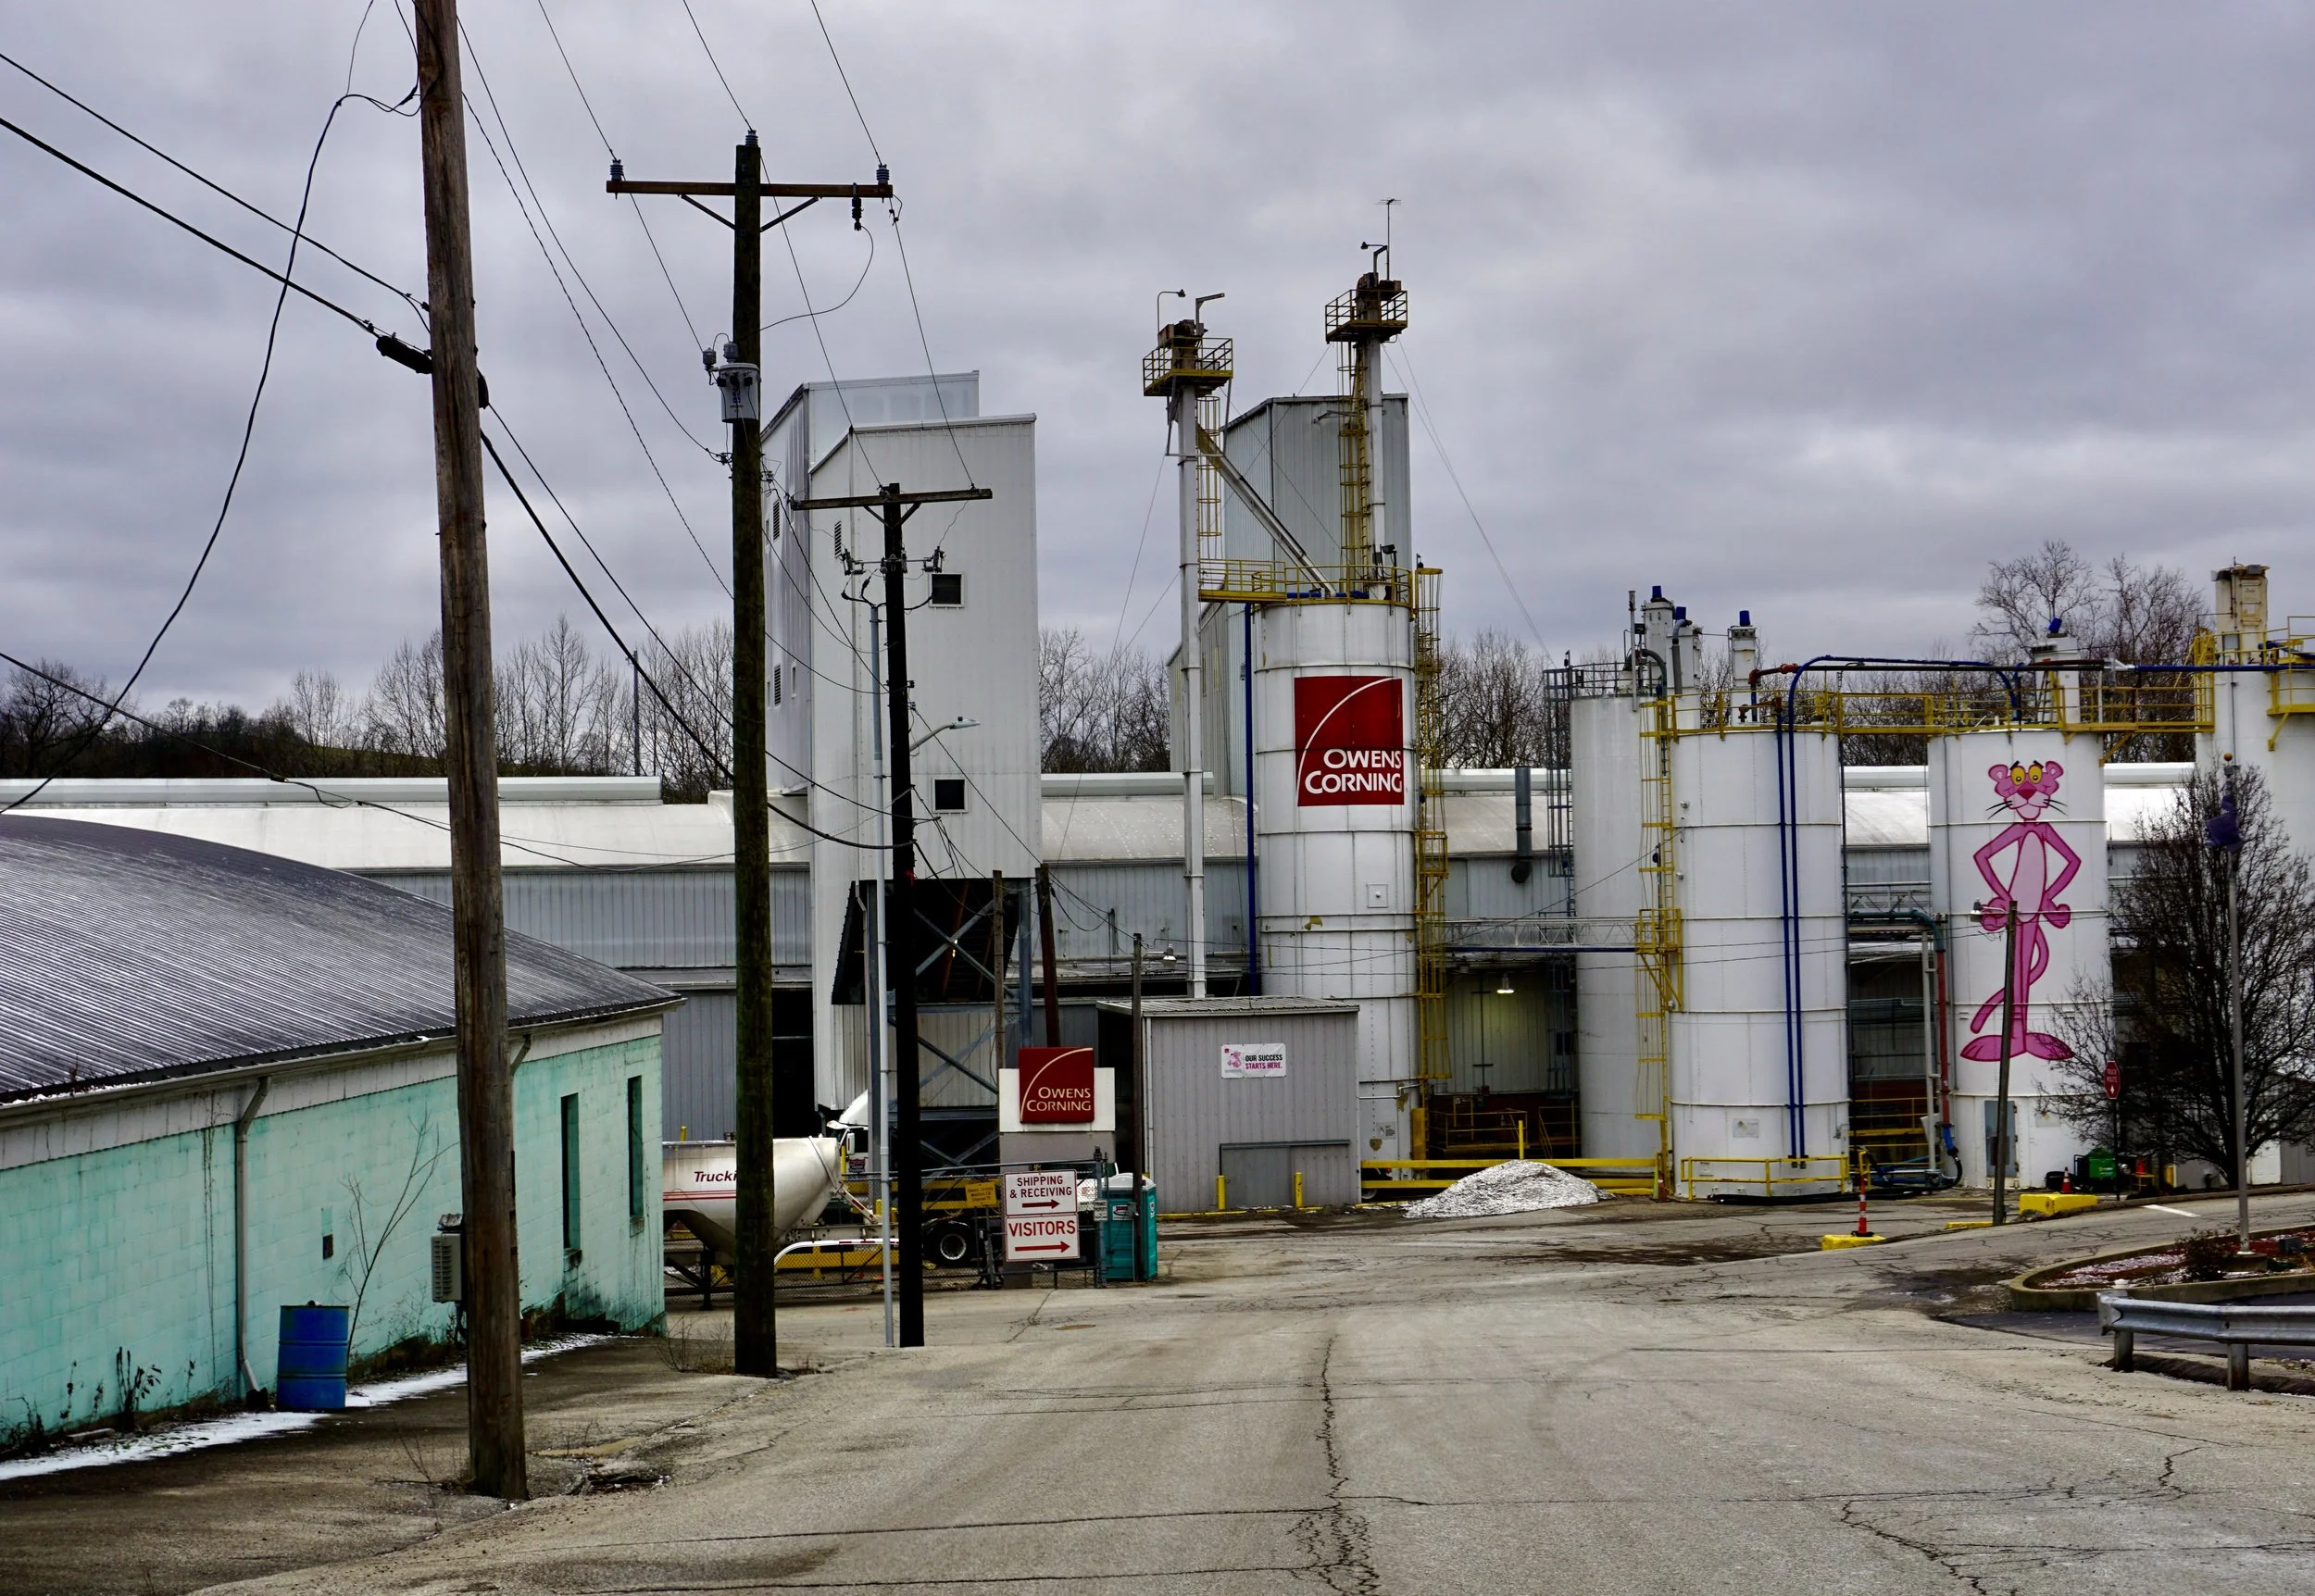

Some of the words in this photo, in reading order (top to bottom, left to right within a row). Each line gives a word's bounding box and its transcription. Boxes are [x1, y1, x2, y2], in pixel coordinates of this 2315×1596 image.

[1323, 748, 1402, 769] OWENS
[1305, 770, 1403, 794] CORNING
[1038, 1087, 1091, 1099] OWENS
[1026, 1100, 1092, 1112] CORNING
[1017, 1175, 1063, 1187] SHIPPING
[1009, 1189, 1018, 1199] &
[1020, 1186, 1072, 1198] RECEIVING
[1008, 1220, 1076, 1237] VISITORS
